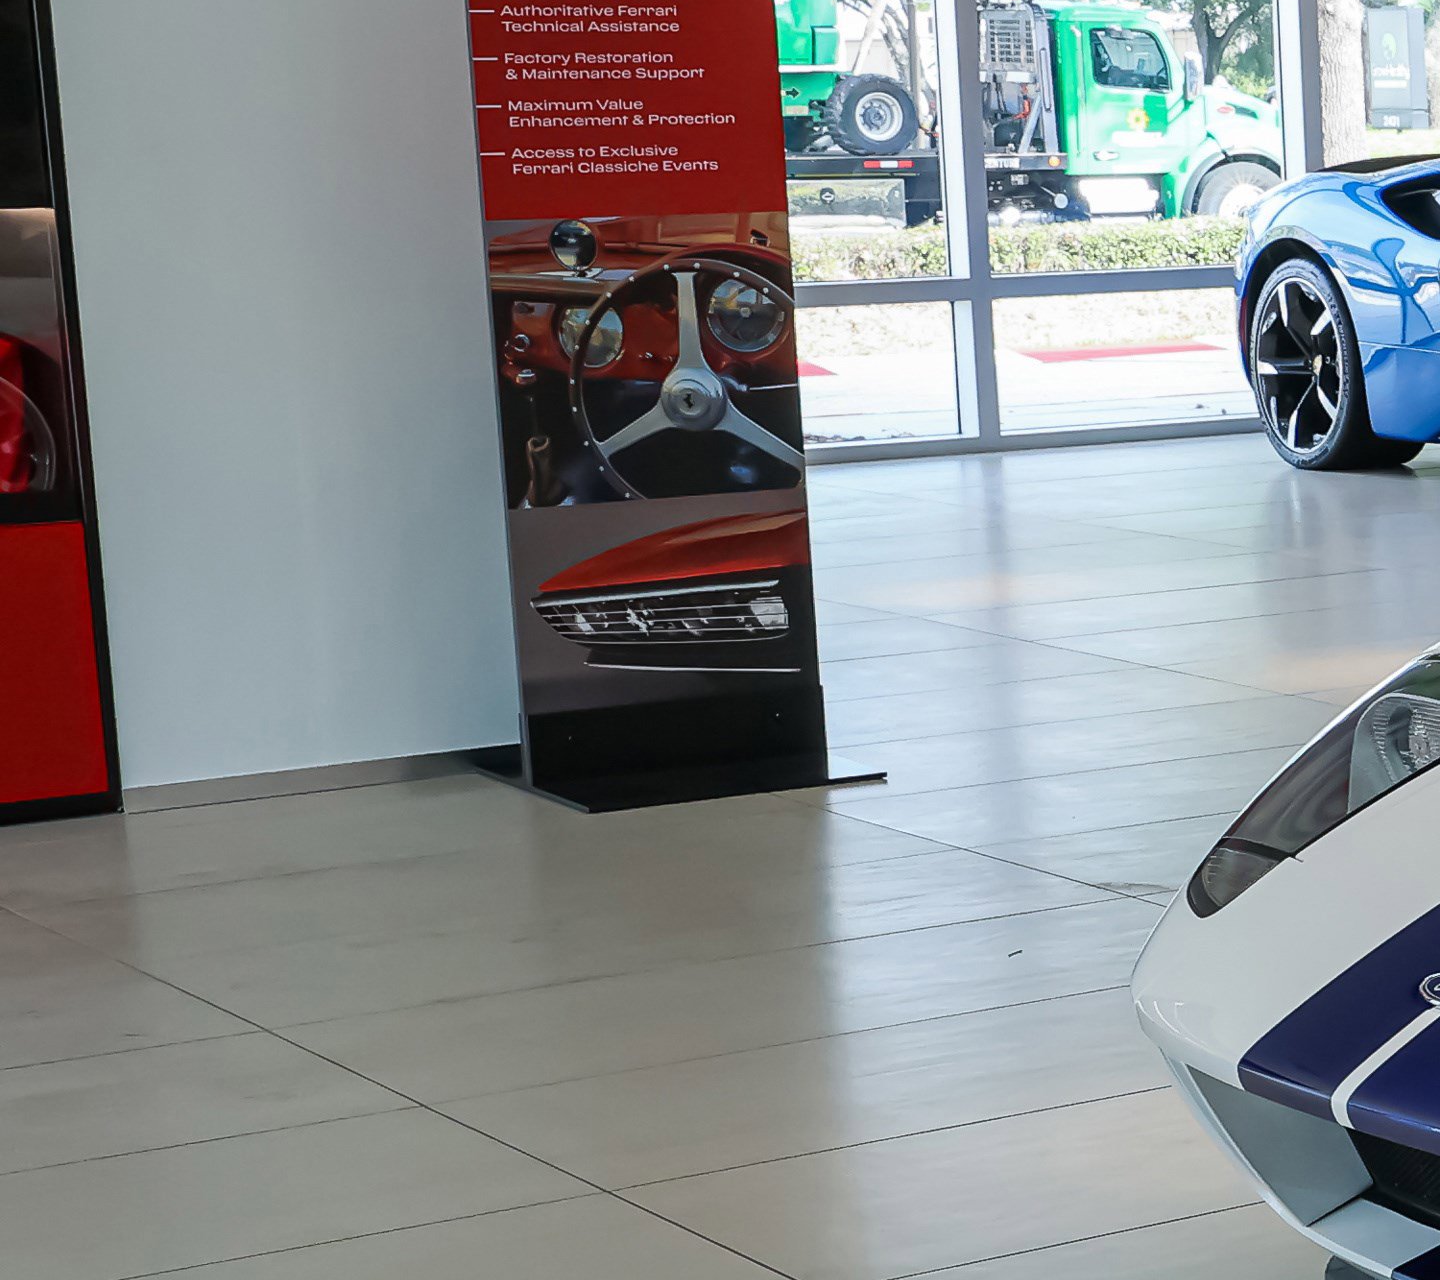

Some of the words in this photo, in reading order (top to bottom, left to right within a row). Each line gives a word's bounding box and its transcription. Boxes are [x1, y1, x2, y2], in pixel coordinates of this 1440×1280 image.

[499, 4, 614, 17] Authoritative
[617, 4, 677, 17] Ferrari
[501, 20, 584, 32] Technical
[587, 20, 680, 32] Assistance
[504, 52, 571, 66] Factory
[574, 51, 674, 64] Restoration
[505, 68, 518, 80] &
[522, 68, 632, 80] Maintenance
[635, 67, 705, 81] Support
[508, 99, 593, 112] Maximum
[595, 98, 644, 111] Value
[509, 115, 629, 128] Enhancement
[632, 114, 644, 126] &
[648, 112, 736, 125] Protection
[511, 147, 575, 159] Access
[578, 147, 596, 158] to
[599, 144, 678, 157] Exclusive
[512, 161, 574, 175] Ferrari
[577, 160, 659, 174] Classiche
[662, 160, 719, 172] Events
